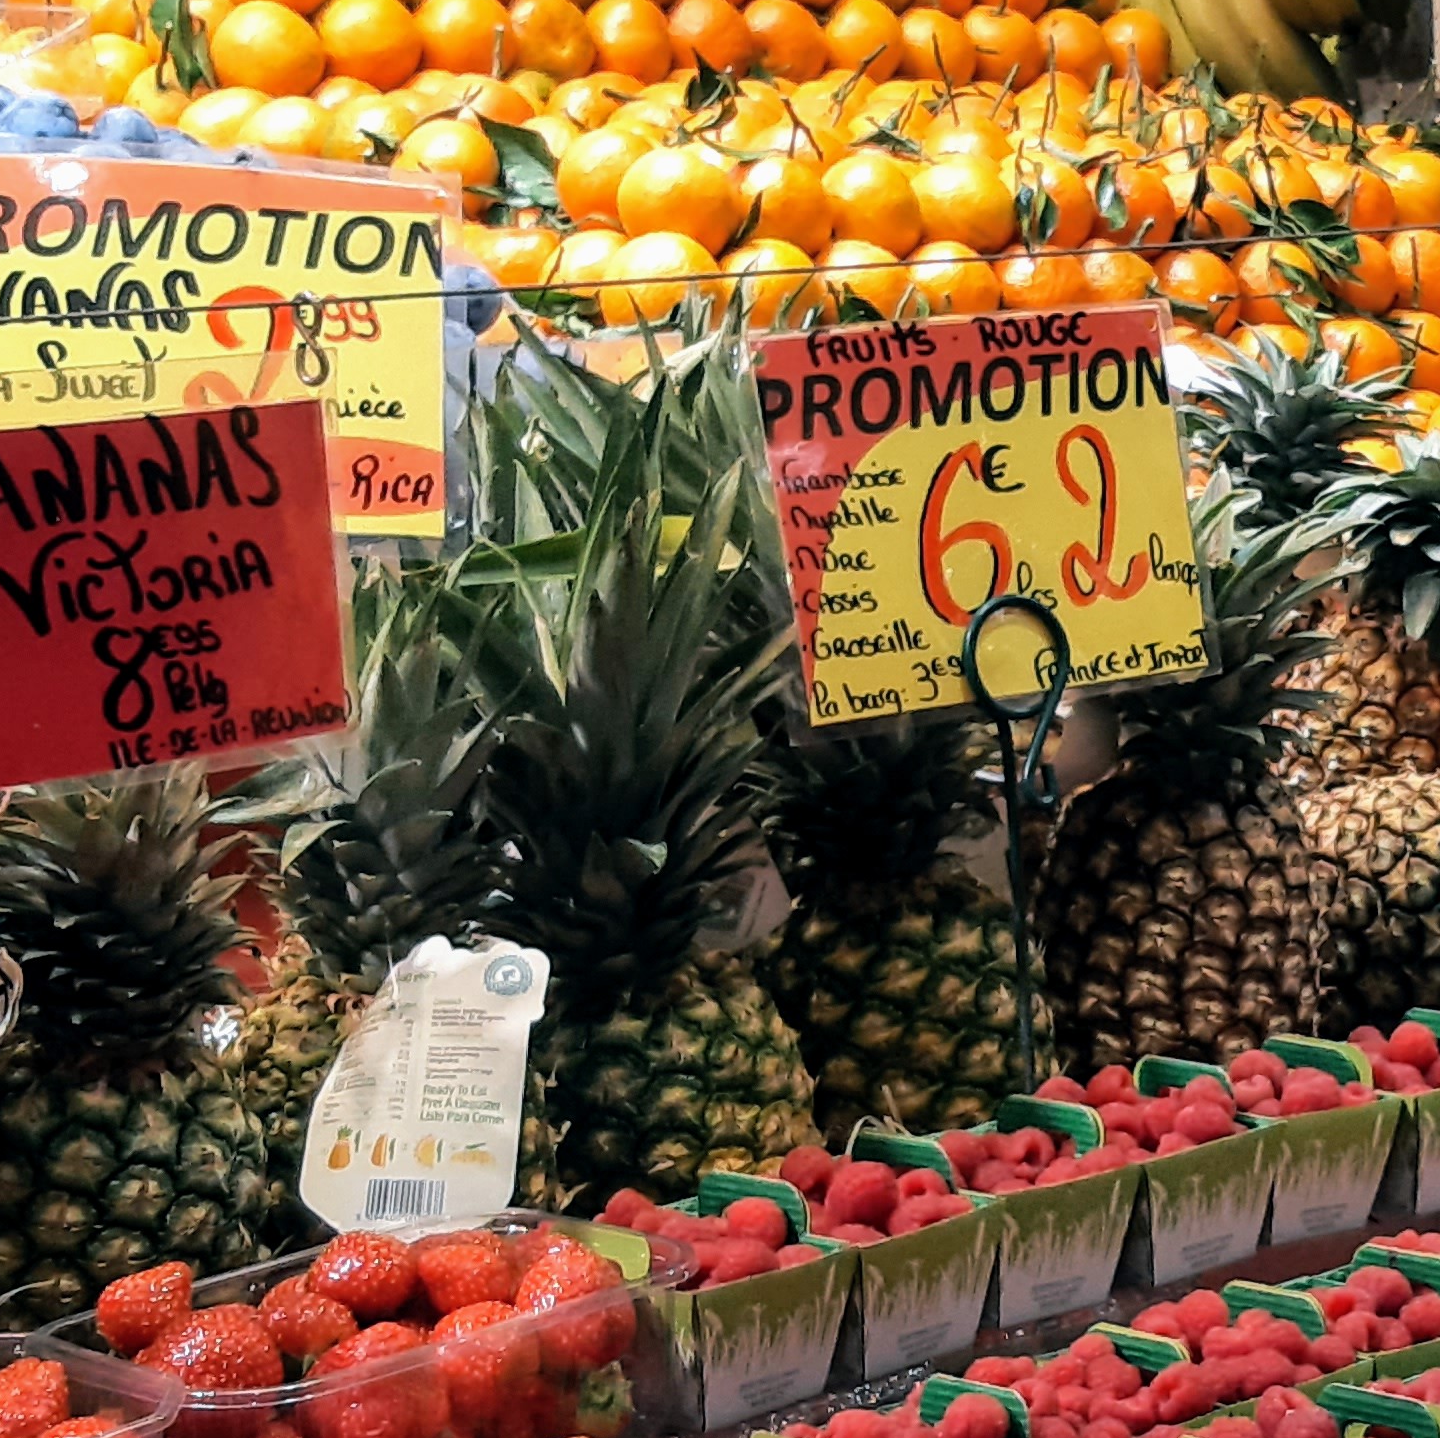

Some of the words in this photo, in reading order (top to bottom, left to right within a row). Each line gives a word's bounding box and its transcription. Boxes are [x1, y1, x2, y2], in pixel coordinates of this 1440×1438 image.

[972, 311, 1094, 353] ROUGE
[756, 346, 1170, 442] PROMOTION
[350, 453, 435, 511] RICA
[1055, 423, 1149, 607] 2
